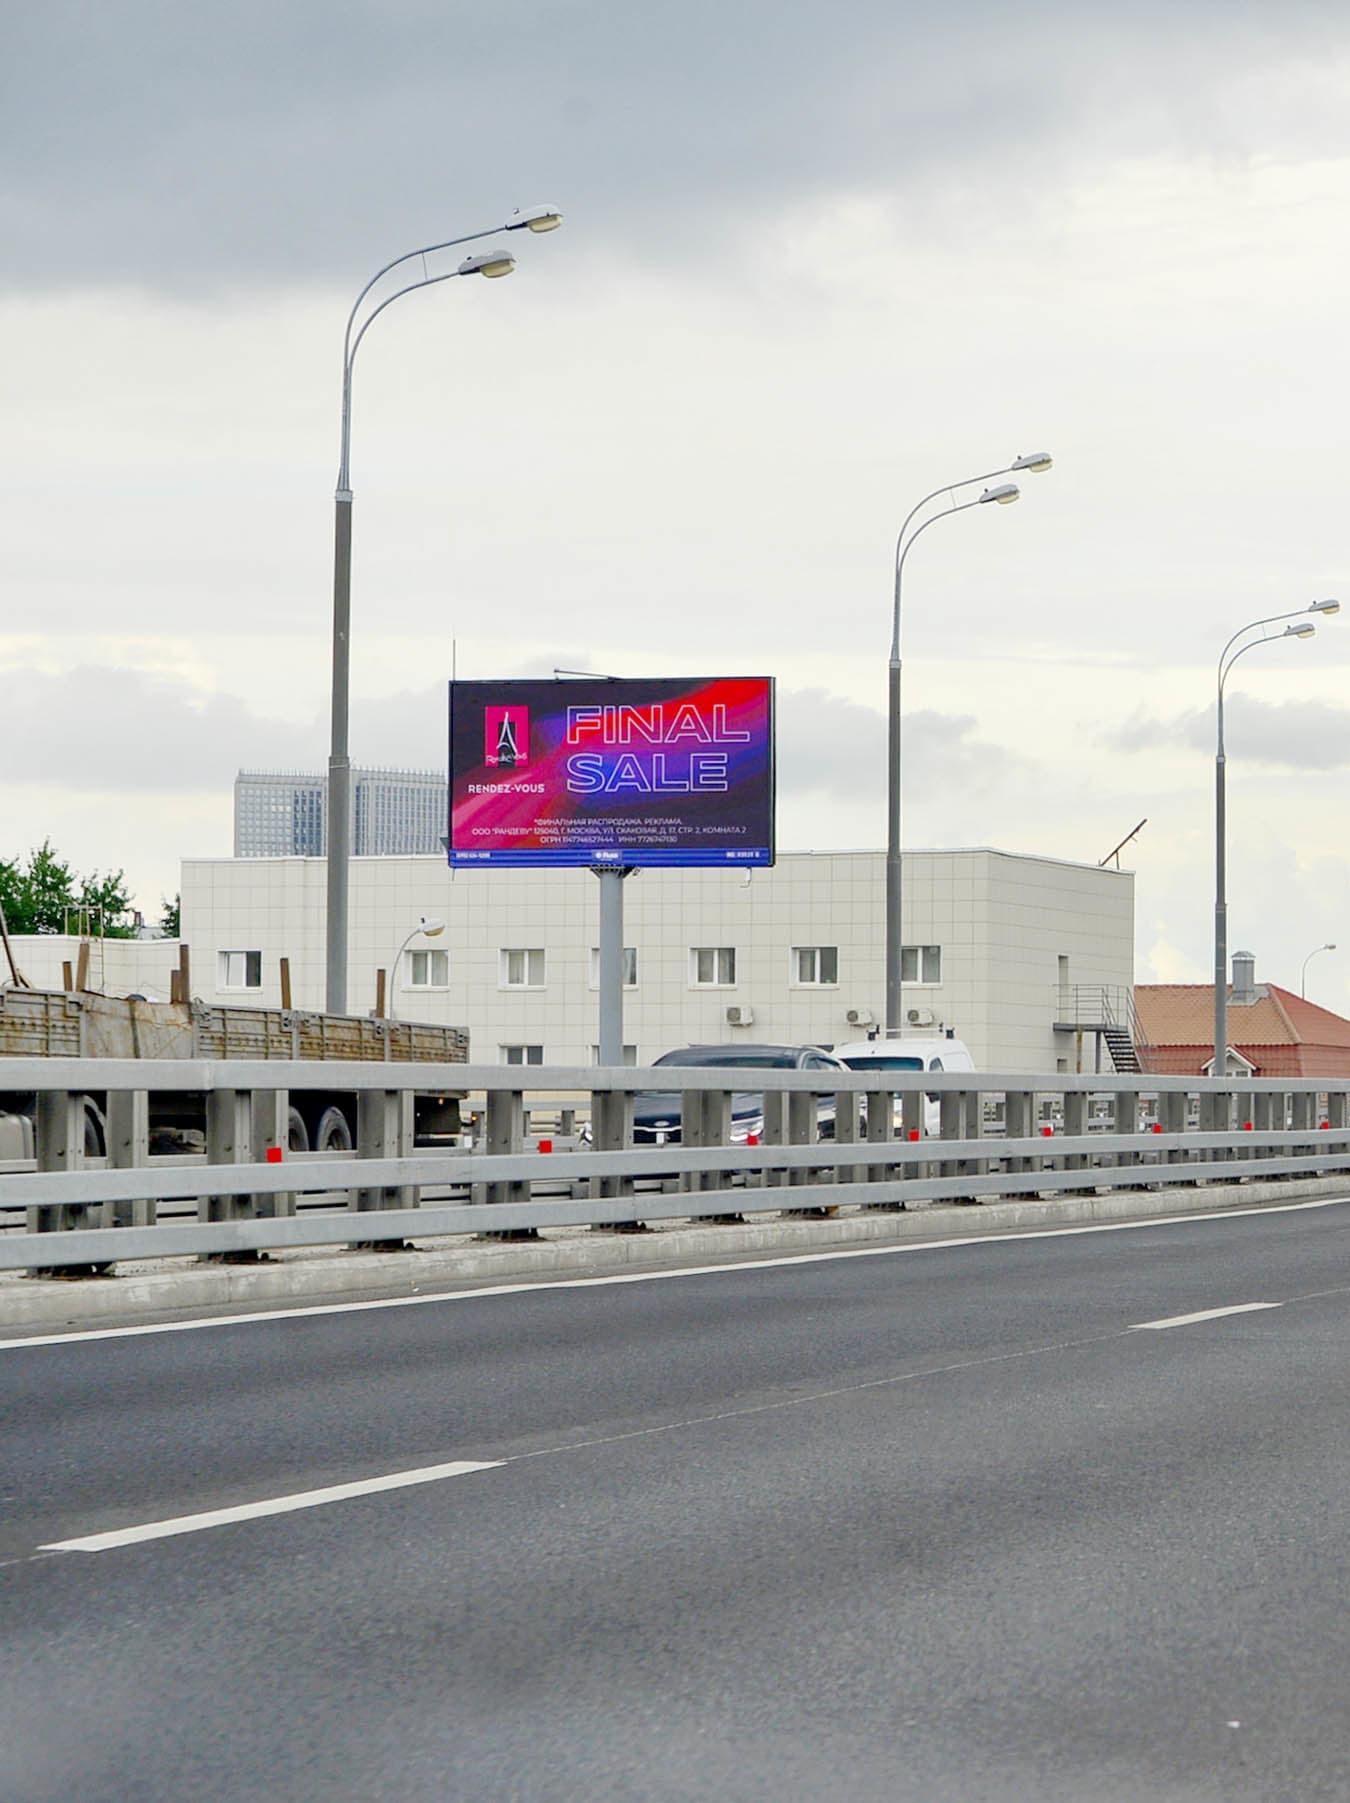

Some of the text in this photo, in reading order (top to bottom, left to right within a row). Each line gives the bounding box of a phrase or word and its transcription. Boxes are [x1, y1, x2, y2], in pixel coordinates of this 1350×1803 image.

[566, 704, 750, 744] FINAL
[468, 784, 545, 793] RENDEZ-VOUS
[566, 753, 728, 793] SALE
